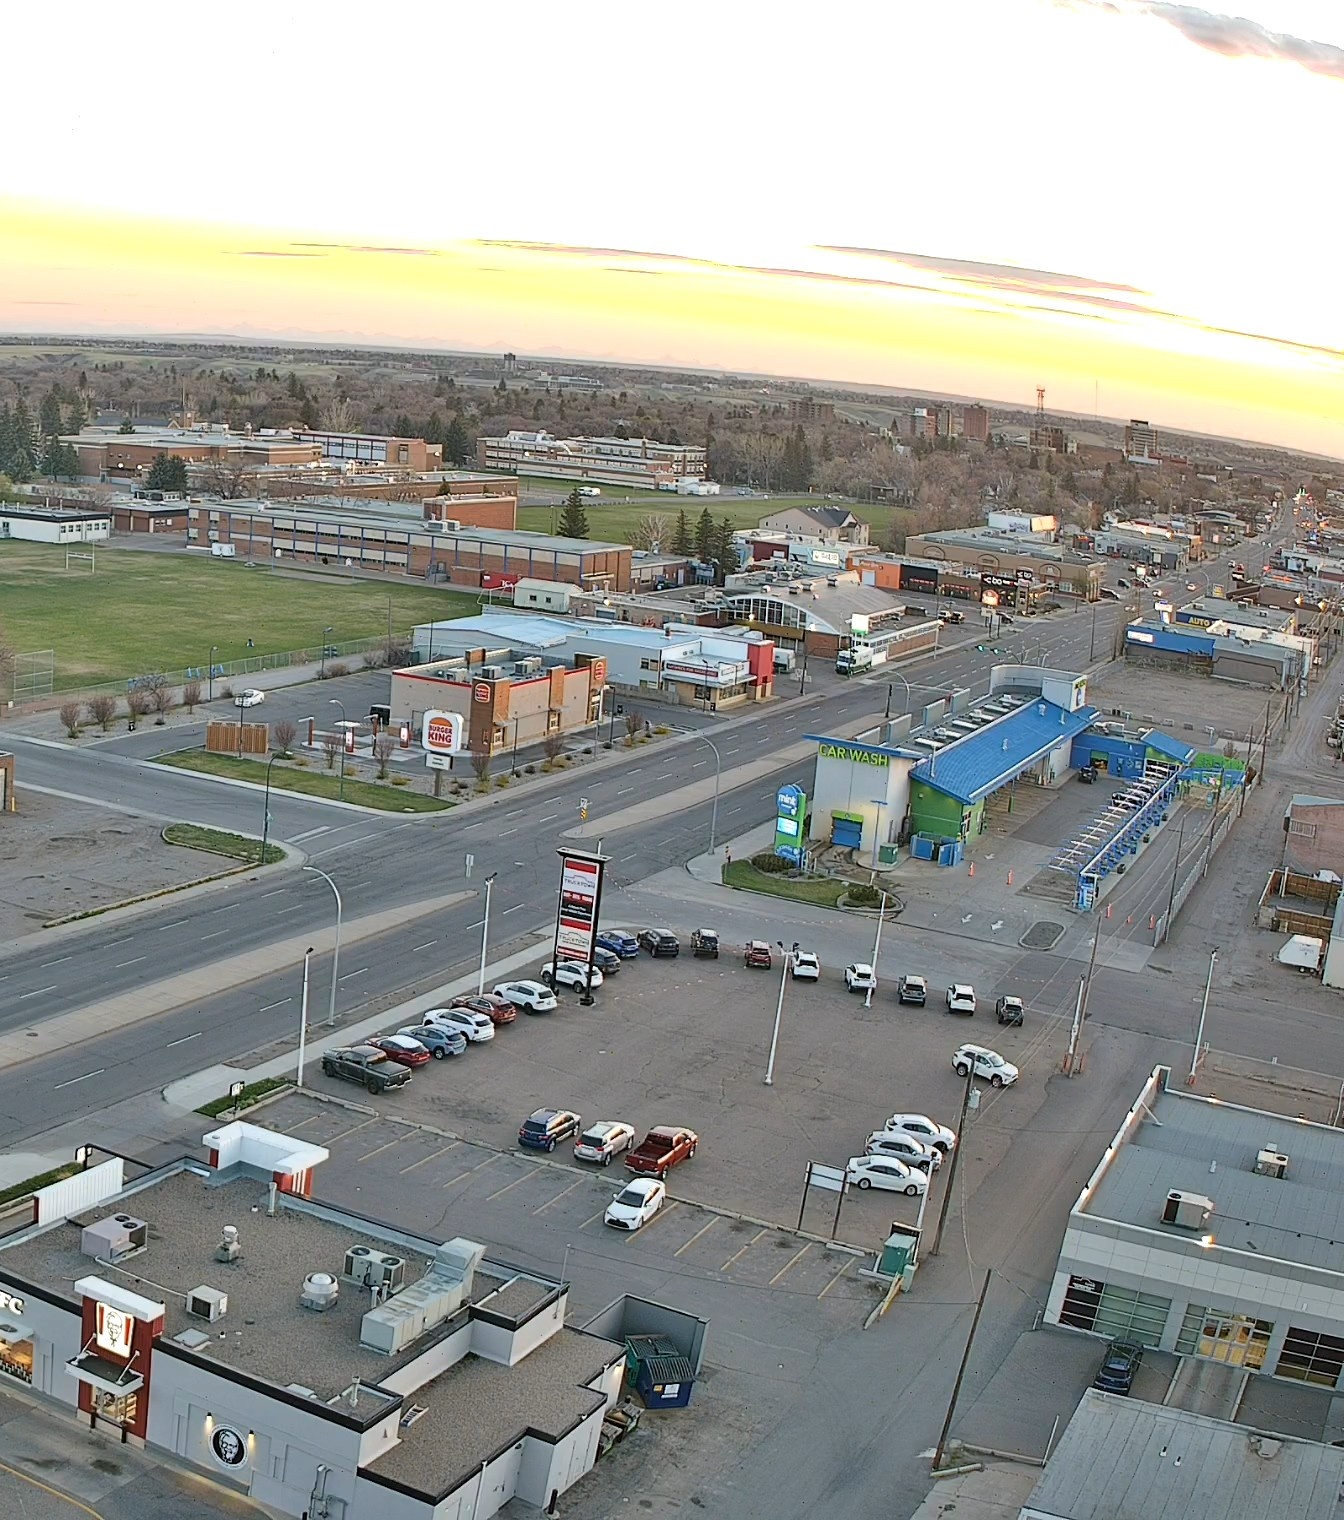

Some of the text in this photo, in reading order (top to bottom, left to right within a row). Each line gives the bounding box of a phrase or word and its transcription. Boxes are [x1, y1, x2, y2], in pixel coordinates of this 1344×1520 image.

[1188, 616, 1211, 627] AUTO
[429, 725, 453, 735] BURGER
[428, 732, 451, 743] KING
[819, 744, 889, 768] CAR WASH
[778, 794, 797, 806] mint
